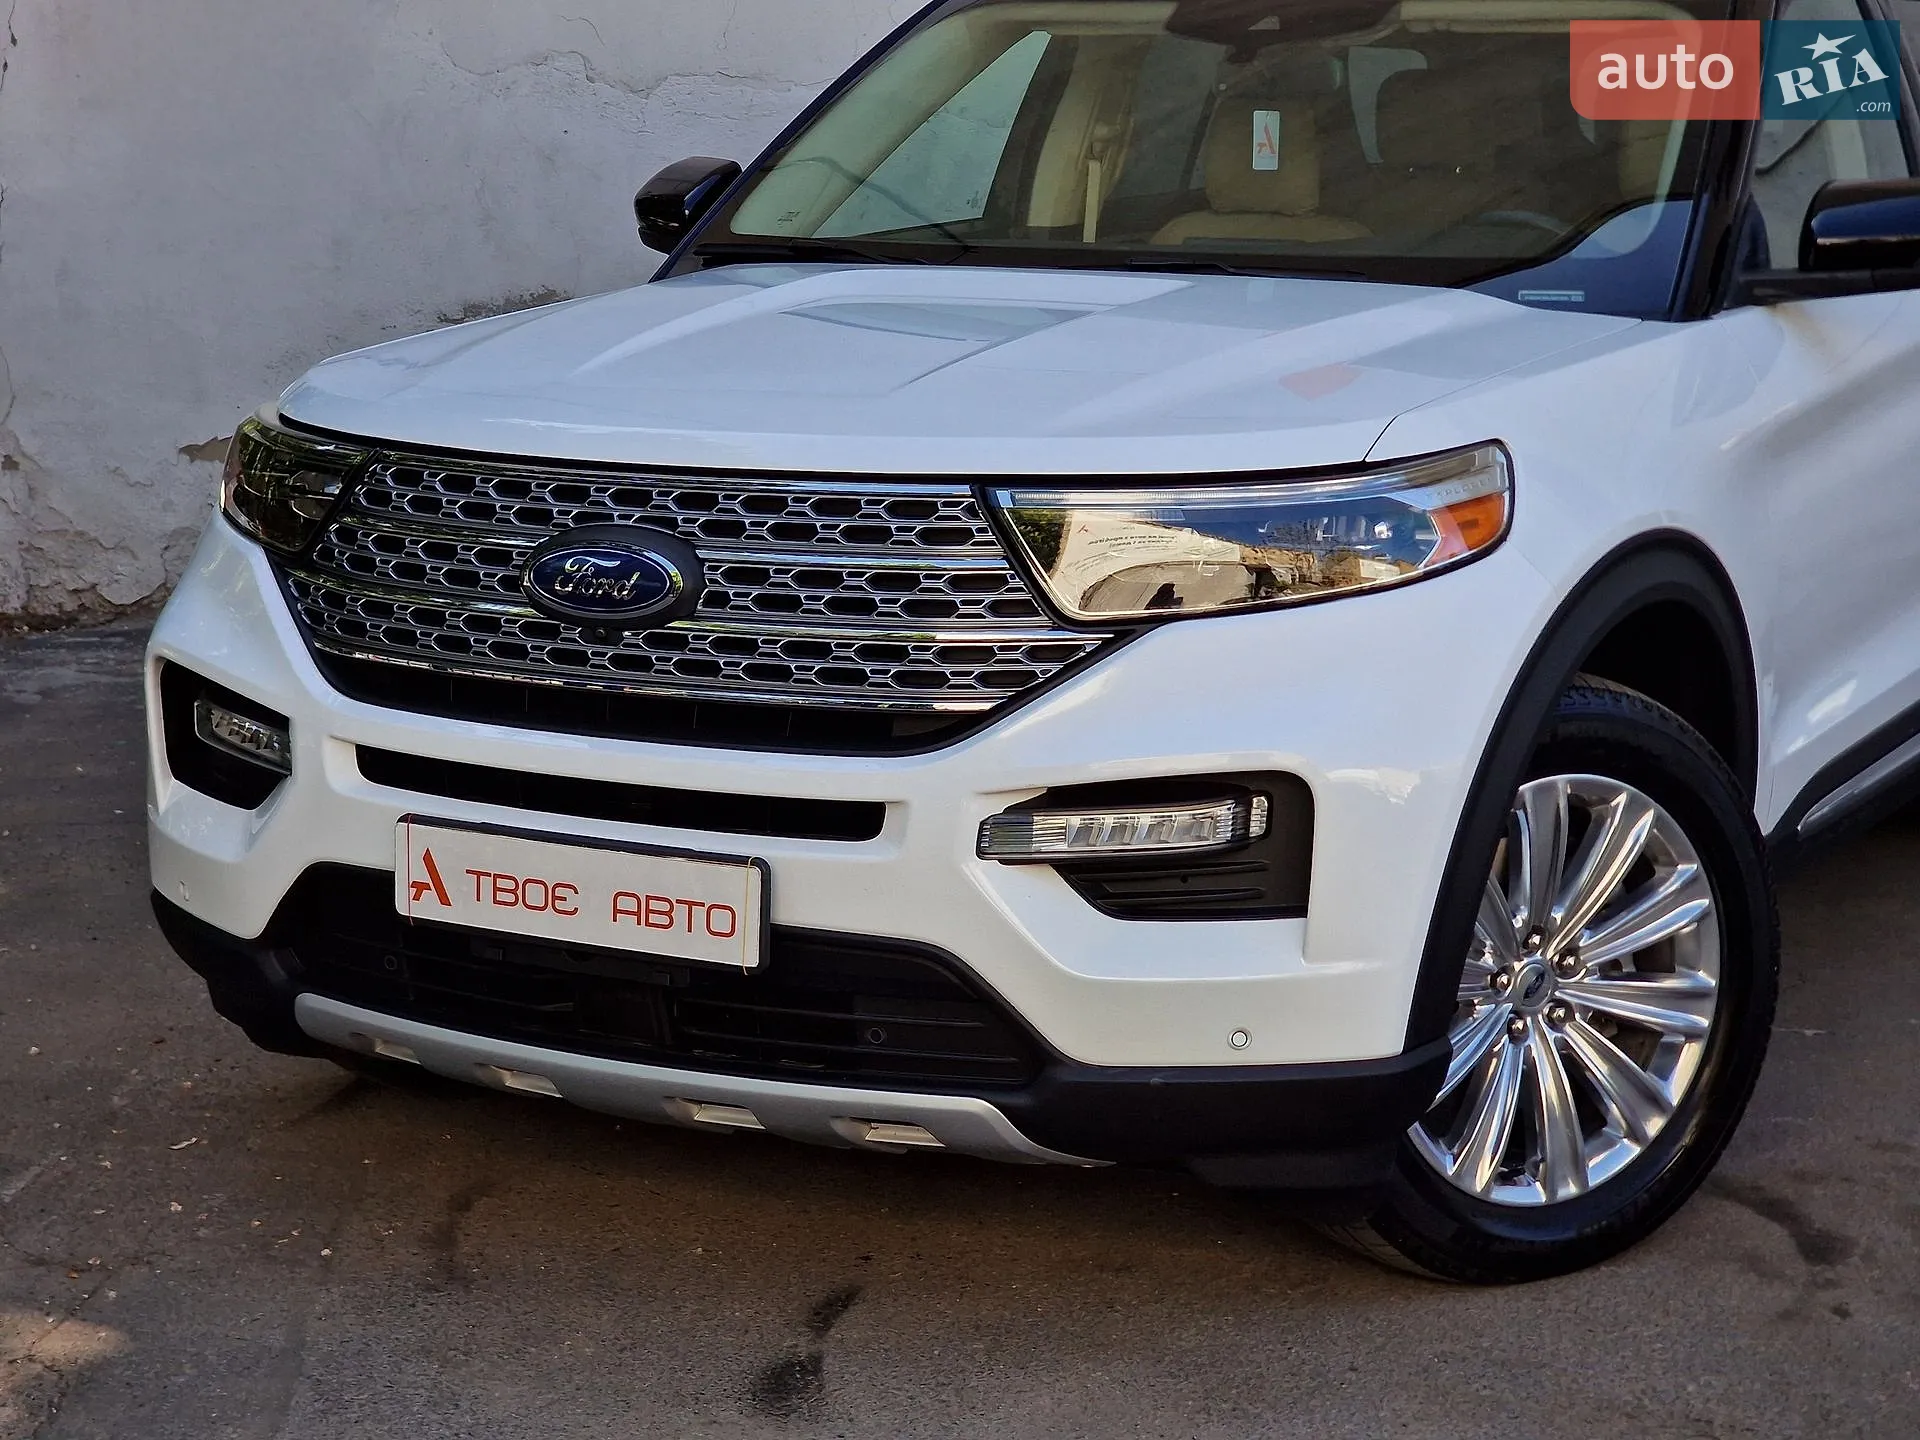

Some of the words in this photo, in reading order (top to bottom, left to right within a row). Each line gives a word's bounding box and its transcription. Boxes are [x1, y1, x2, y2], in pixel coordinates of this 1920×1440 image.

[554, 555, 641, 600] Ford
[465, 868, 579, 917] ТВОЄ
[612, 890, 737, 939] АВТО
